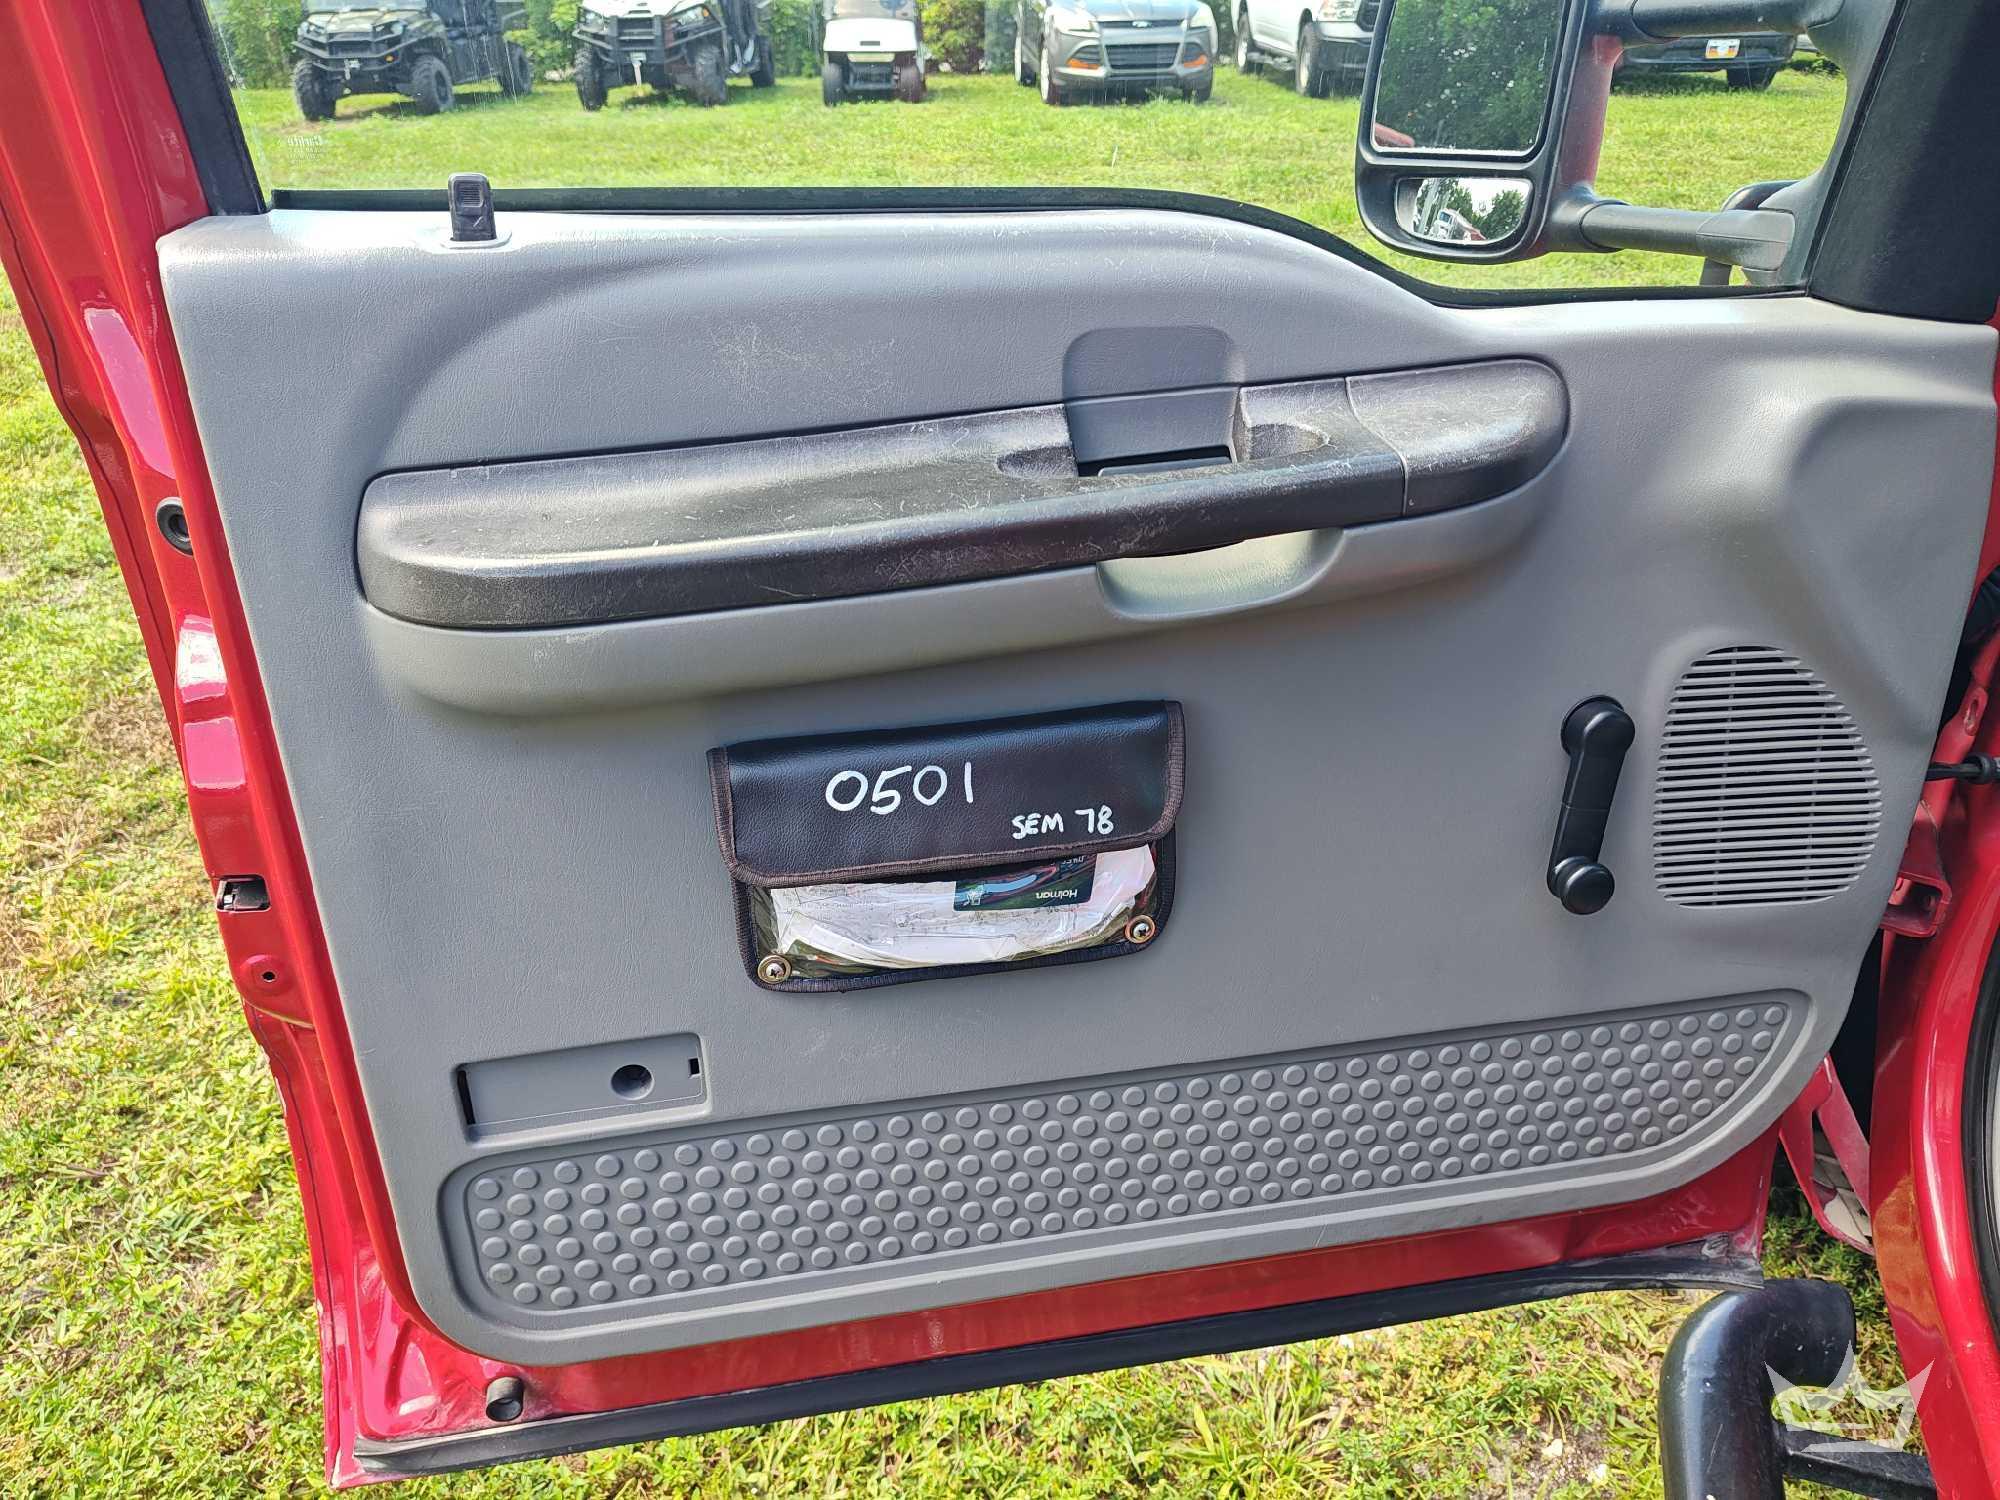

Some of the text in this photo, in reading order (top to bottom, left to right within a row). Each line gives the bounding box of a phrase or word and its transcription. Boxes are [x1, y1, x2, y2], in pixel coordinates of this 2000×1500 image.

[825, 762, 974, 815] 0501
[1011, 805, 1114, 840] SEM 78
[1035, 888, 1079, 900] Holman
